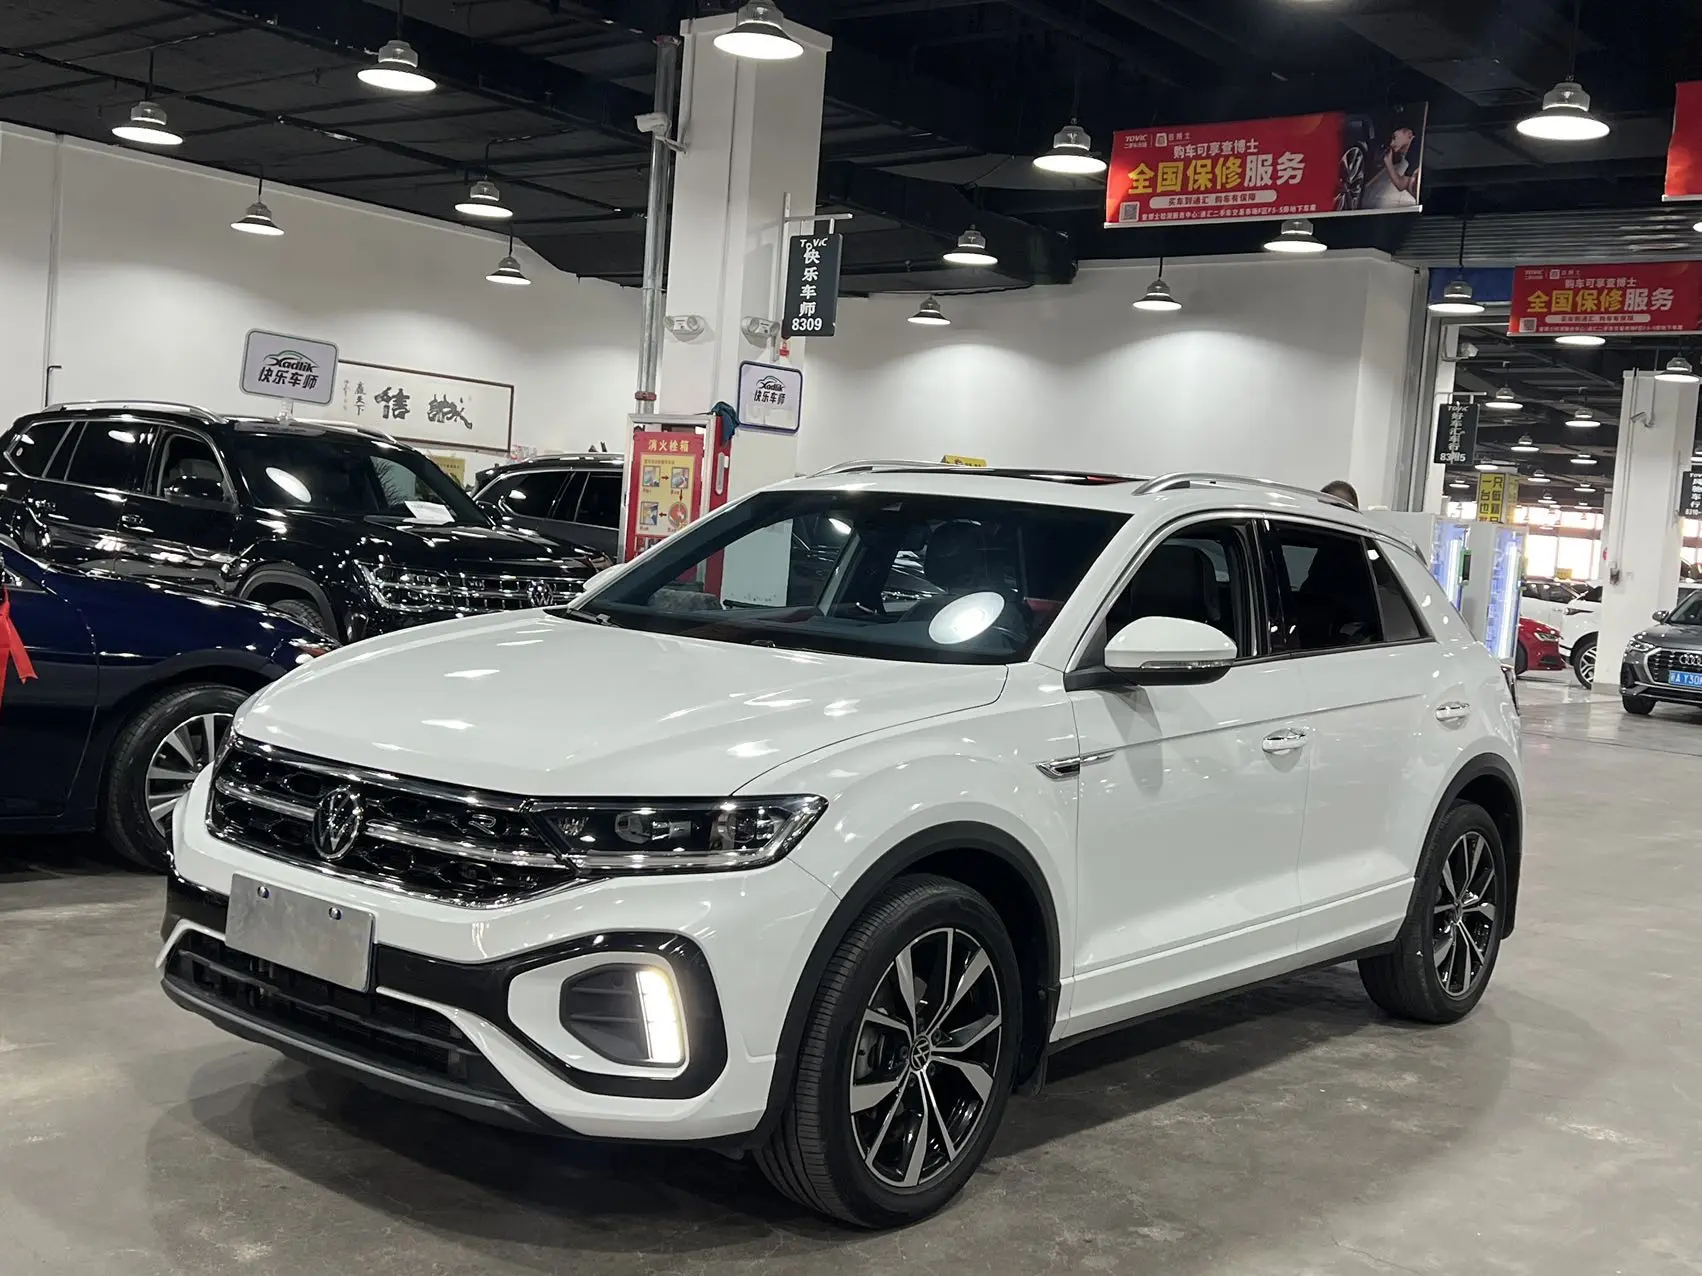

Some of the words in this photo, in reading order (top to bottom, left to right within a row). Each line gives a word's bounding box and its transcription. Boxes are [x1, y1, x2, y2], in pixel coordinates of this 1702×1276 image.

[1173, 138, 1259, 159] 购车可享查博士
[1127, 151, 1306, 195] 全国保修服务
[798, 248, 821, 317] 快乐车师
[1526, 287, 1675, 313] 全国保修服务
[791, 317, 823, 331] 8309
[257, 366, 319, 390] 快乐车师
[753, 389, 786, 405] 快乐车师
[648, 439, 690, 452] 消火栓箱
